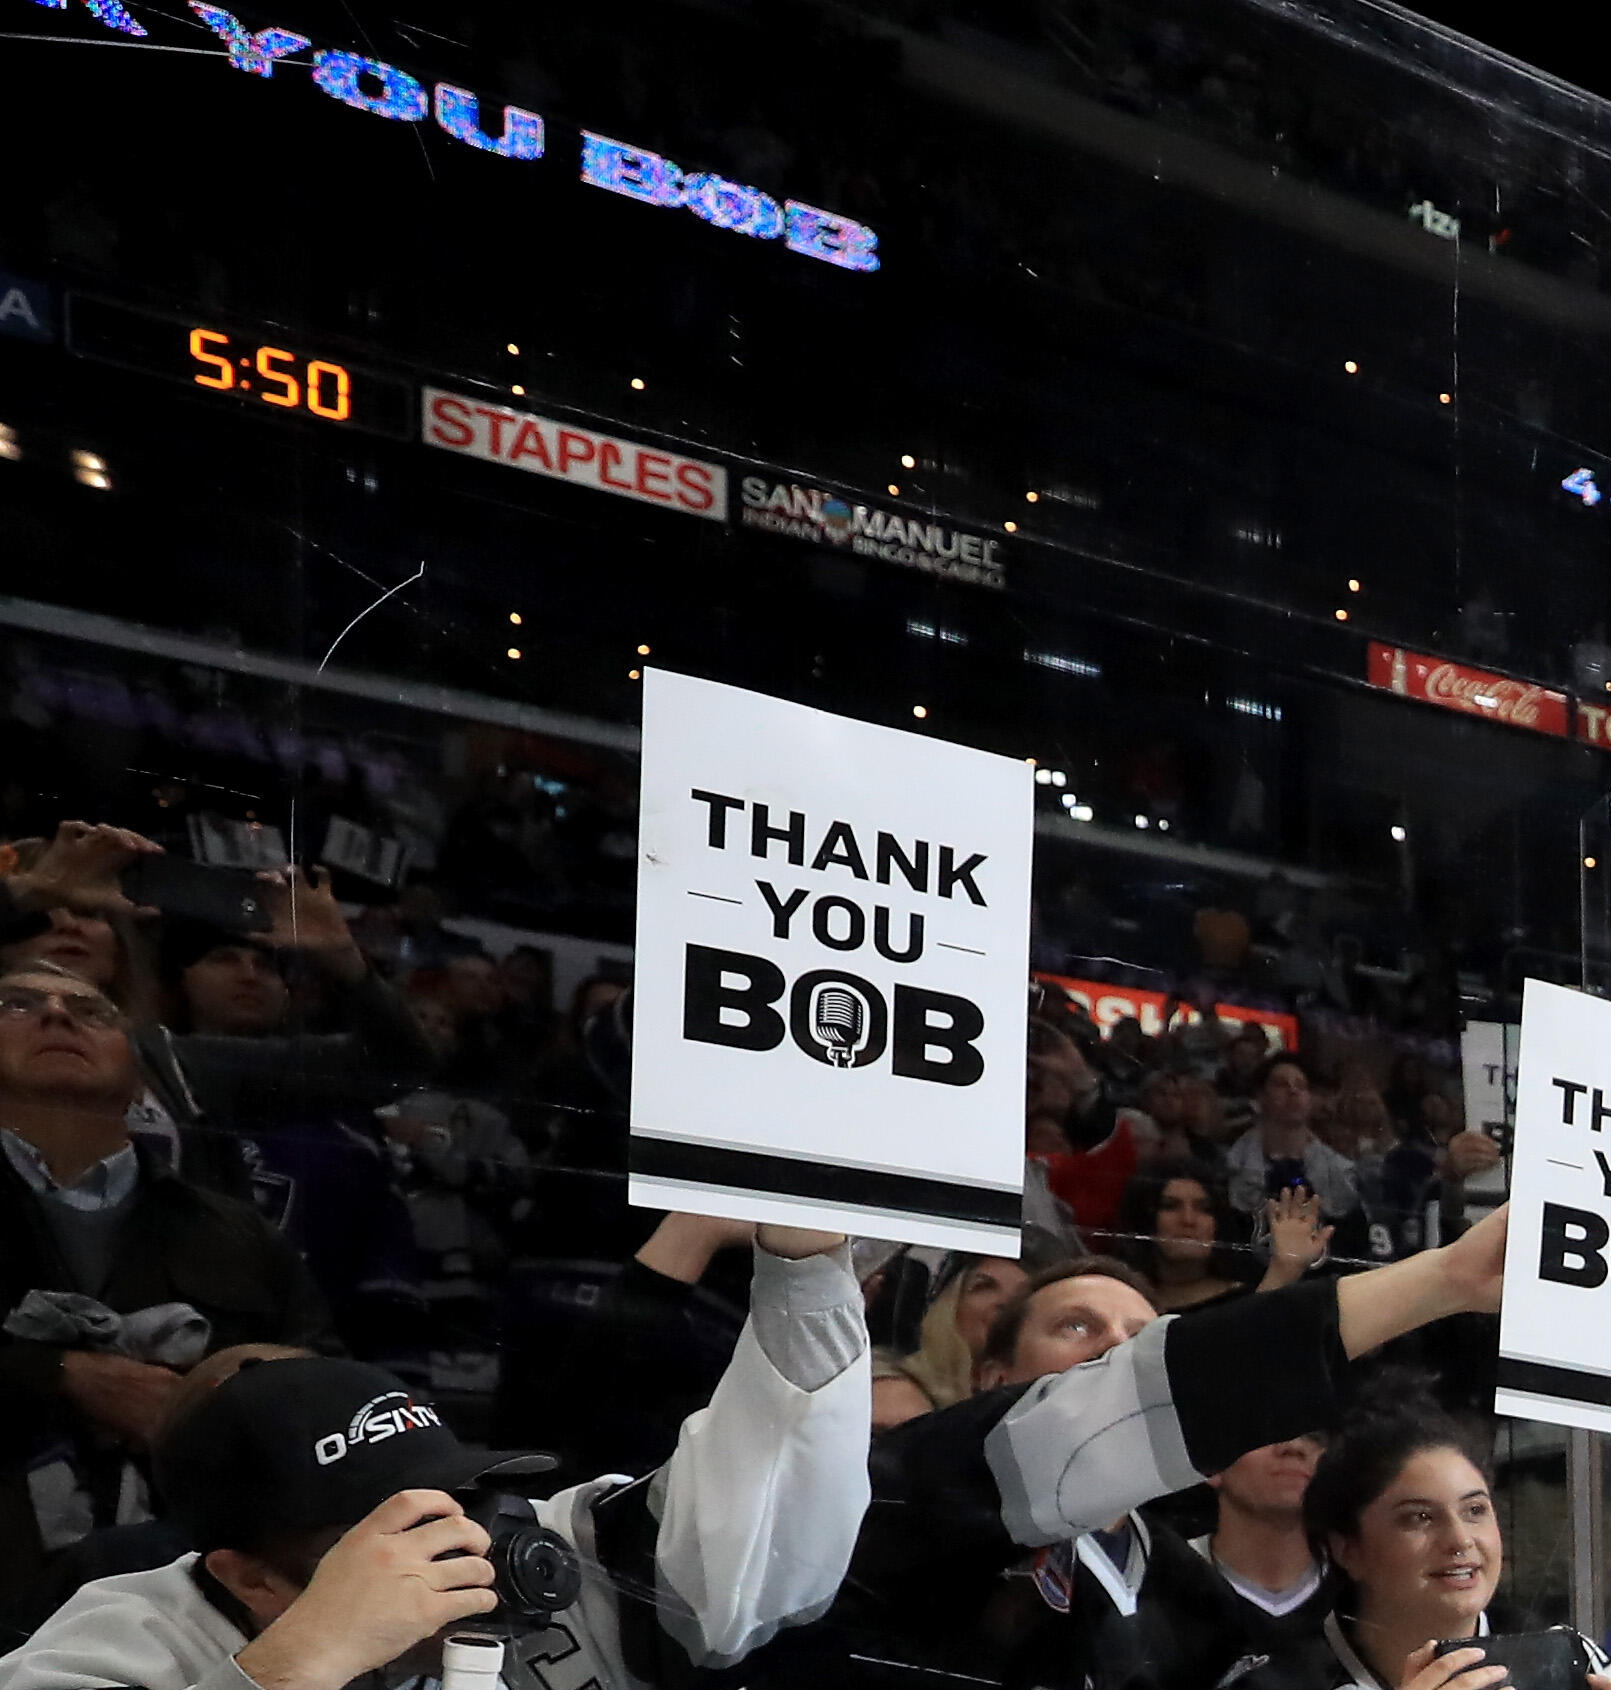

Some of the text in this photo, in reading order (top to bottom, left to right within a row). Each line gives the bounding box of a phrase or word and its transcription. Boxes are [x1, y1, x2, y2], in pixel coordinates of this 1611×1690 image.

[186, 0, 881, 272] YOU BOB
[189, 328, 350, 422] 5:50
[430, 397, 717, 513] STAPLES
[741, 476, 1005, 571] SAN MANUEL
[690, 787, 989, 908] THANK
[754, 879, 925, 964] YOU
[683, 942, 986, 1087] BOB
